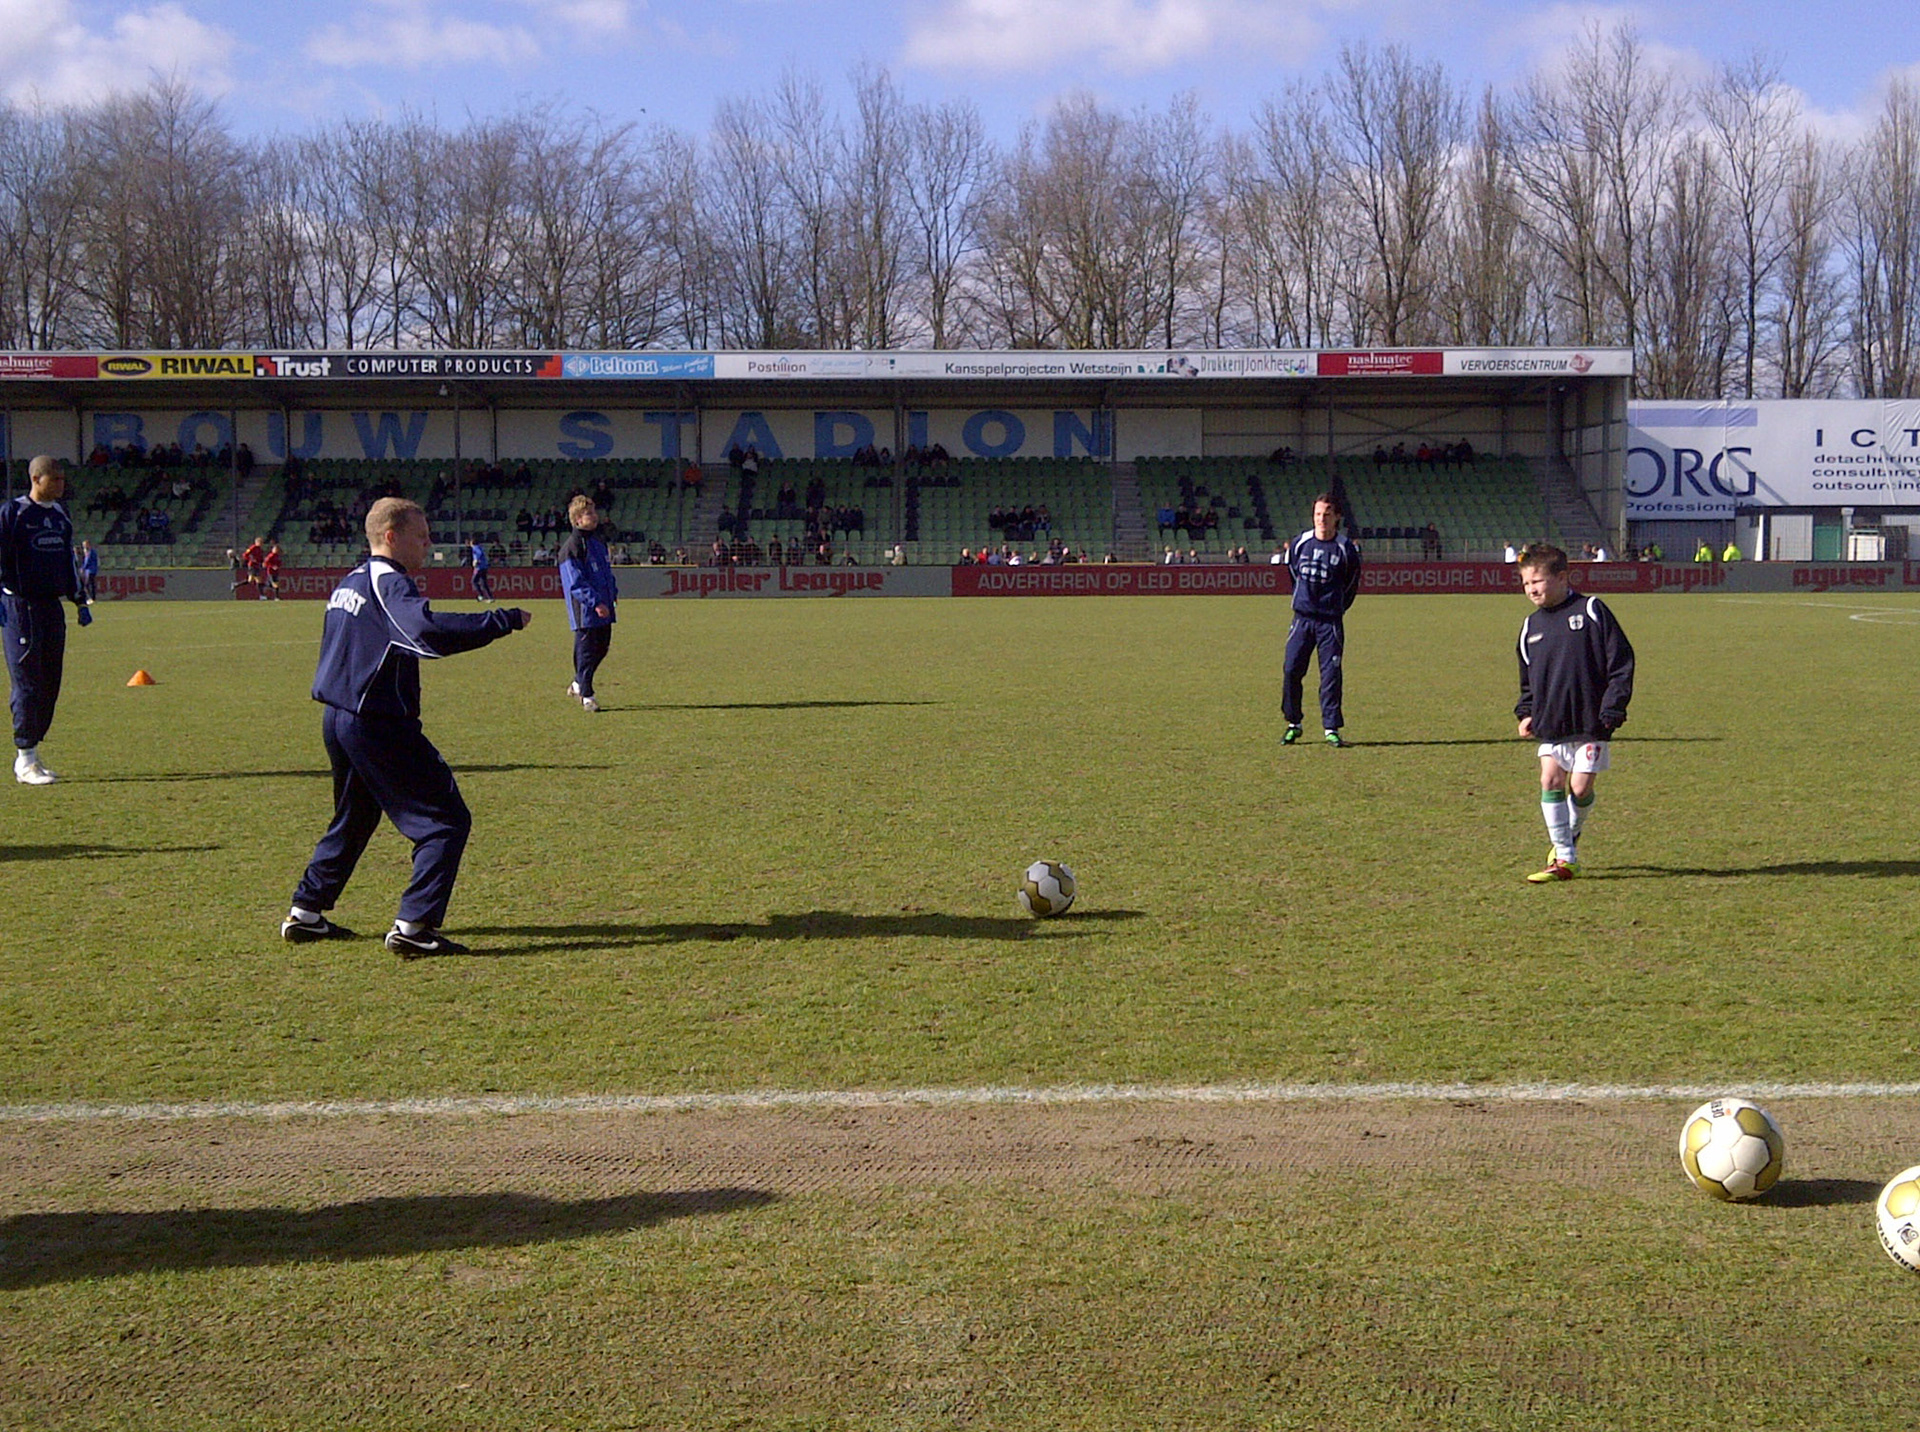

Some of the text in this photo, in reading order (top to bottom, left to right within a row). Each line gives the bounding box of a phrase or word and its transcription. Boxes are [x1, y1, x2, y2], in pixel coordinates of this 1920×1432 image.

[107, 361, 146, 371] RIWAL
[160, 358, 250, 375] RIWAL
[271, 357, 331, 376] Trust
[347, 358, 533, 374] COMPUTER PRODUCTS
[590, 356, 659, 375] Beltona
[748, 361, 806, 373] Postillion
[1347, 352, 1414, 365] nashuatec
[1460, 359, 1568, 372] VERVOERSCENTRUM
[945, 362, 1132, 377] Kansspelprojecten Wetsteijn
[93, 412, 428, 460] BOUW
[557, 411, 1111, 459] STADION
[660, 567, 883, 598] Jupiler League
[977, 571, 1276, 590] ADVERTEREN OP LED BOARDING
